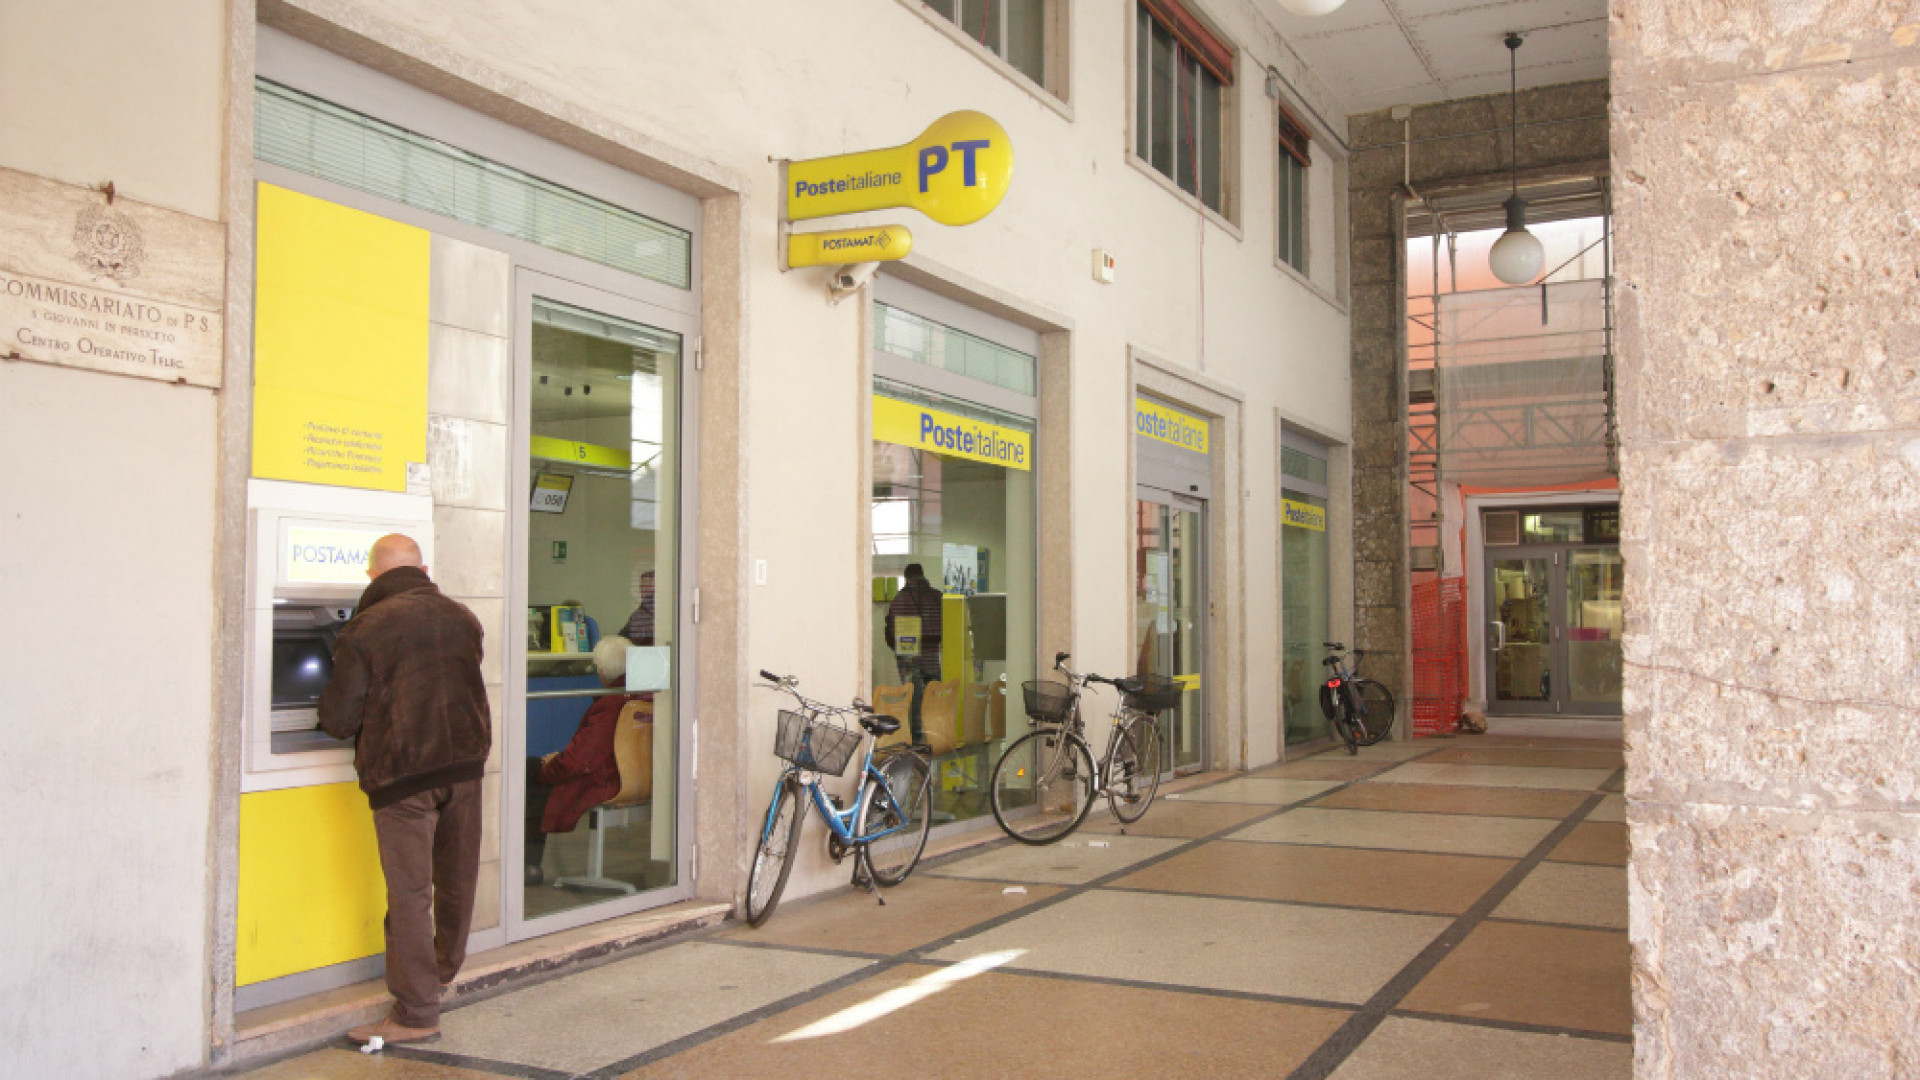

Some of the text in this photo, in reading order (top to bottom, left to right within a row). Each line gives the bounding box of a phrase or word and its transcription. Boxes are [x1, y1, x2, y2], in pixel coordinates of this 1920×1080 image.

[918, 139, 991, 194] PT
[823, 235, 874, 250] POSTAMAT
[44, 310, 99, 330] GIOVANNI
[921, 412, 1024, 464] Posteitaliane
[578, 446, 586, 459] 5
